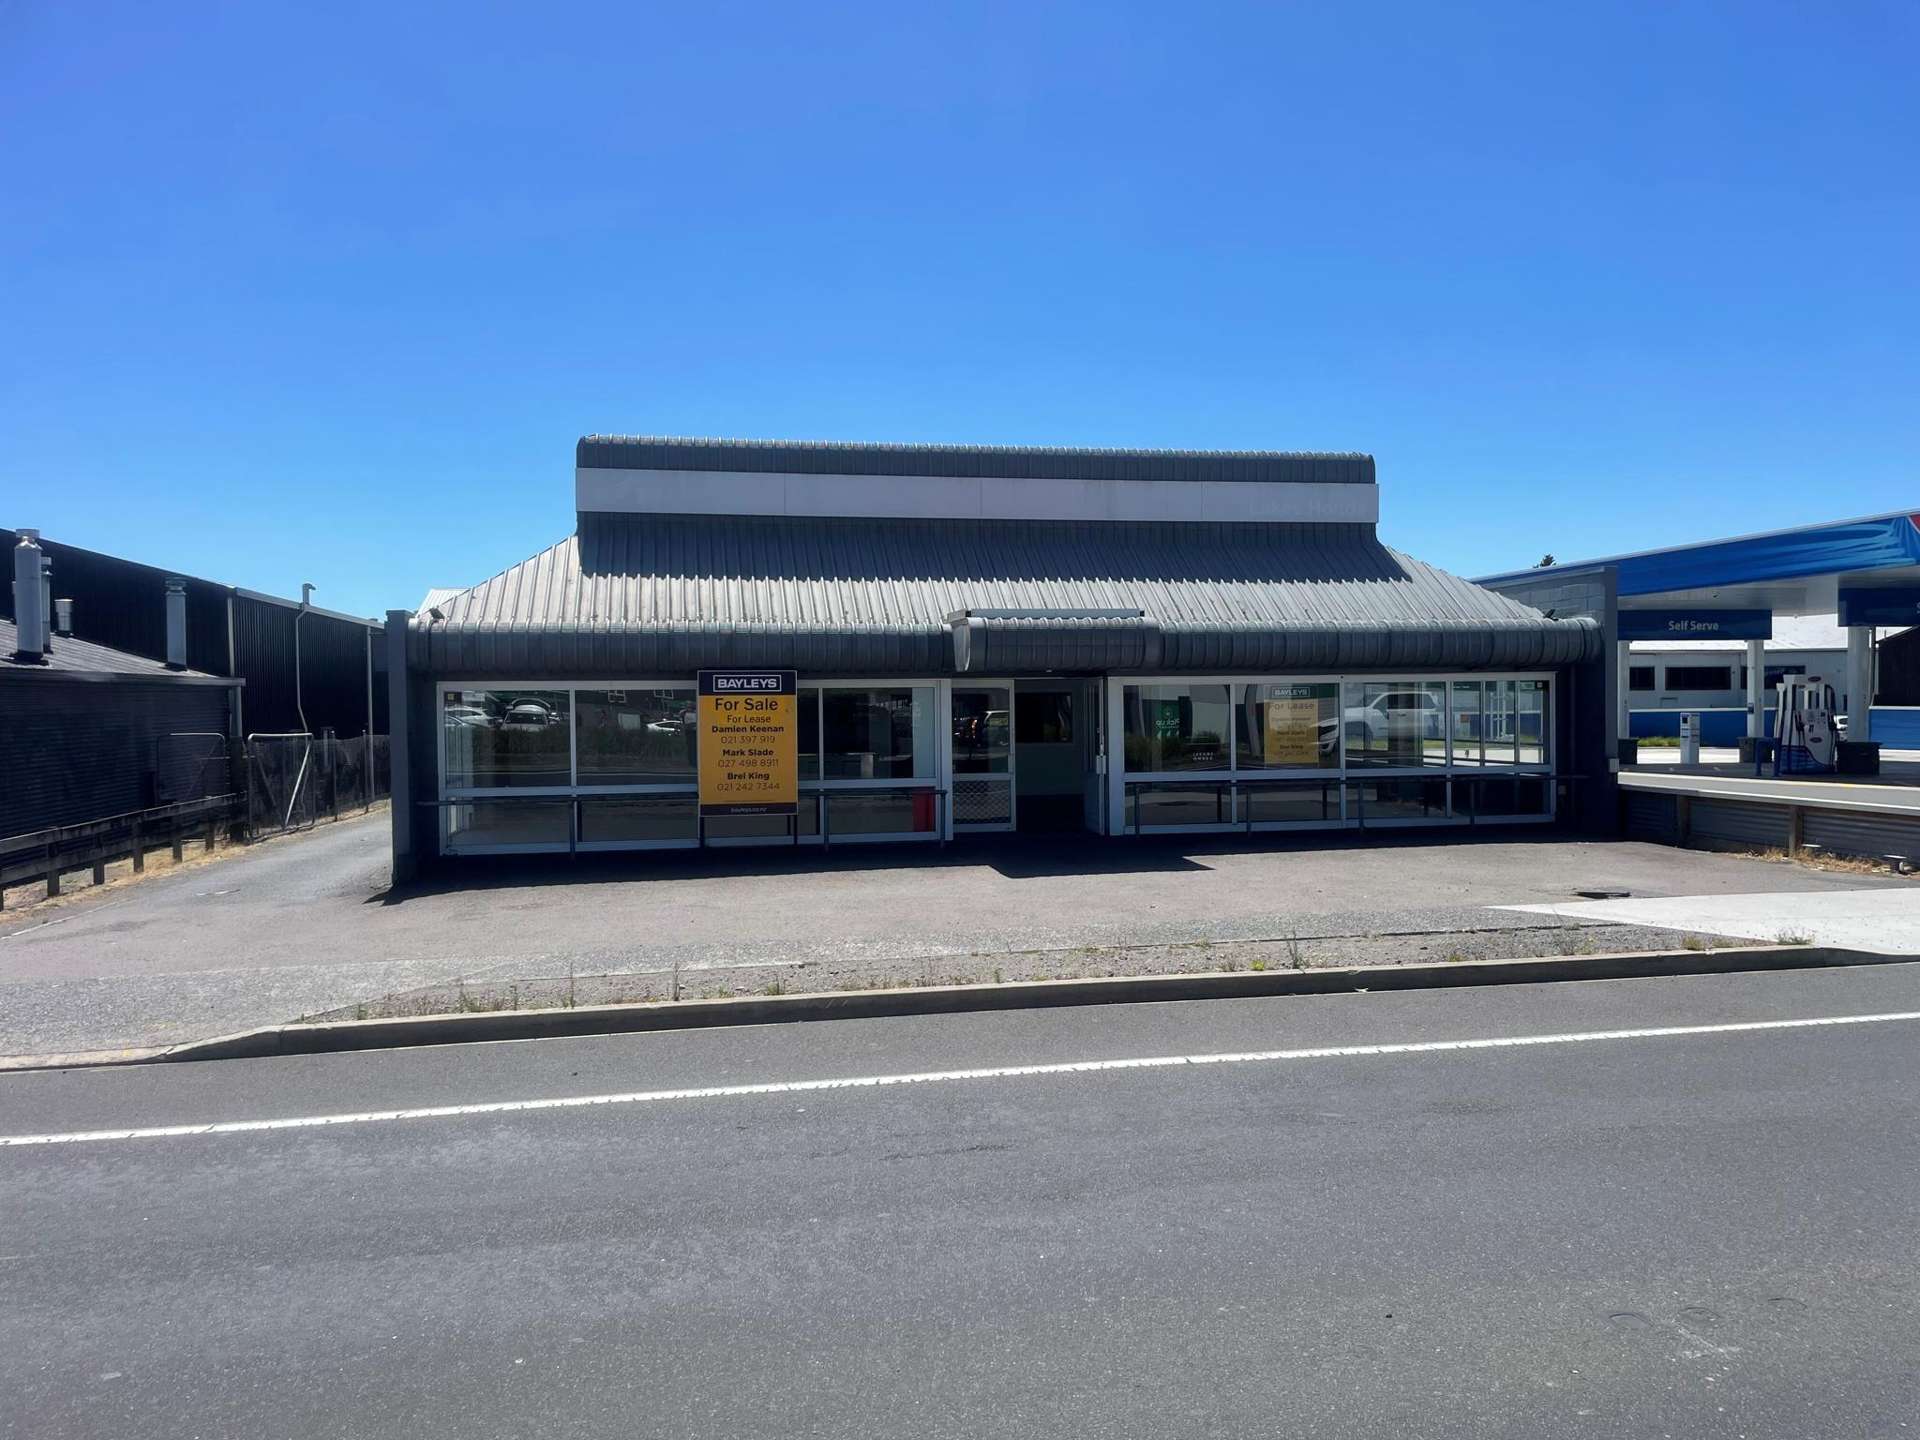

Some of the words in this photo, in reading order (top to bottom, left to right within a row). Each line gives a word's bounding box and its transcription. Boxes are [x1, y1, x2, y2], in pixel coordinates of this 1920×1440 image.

[1668, 620, 1688, 631] Self
[1690, 620, 1719, 631] Serve
[717, 678, 777, 689] BAYLEYS
[715, 698, 738, 711] For
[744, 697, 778, 711] Sale
[727, 715, 742, 723] For
[744, 715, 771, 723] Lease
[712, 725, 747, 733] Damien
[750, 725, 784, 733] Keenan
[720, 736, 737, 744] 021
[722, 749, 746, 757] Mark
[748, 748, 774, 757] Slade
[718, 760, 736, 768] 027
[748, 772, 770, 781] King
[716, 784, 733, 792] 021
